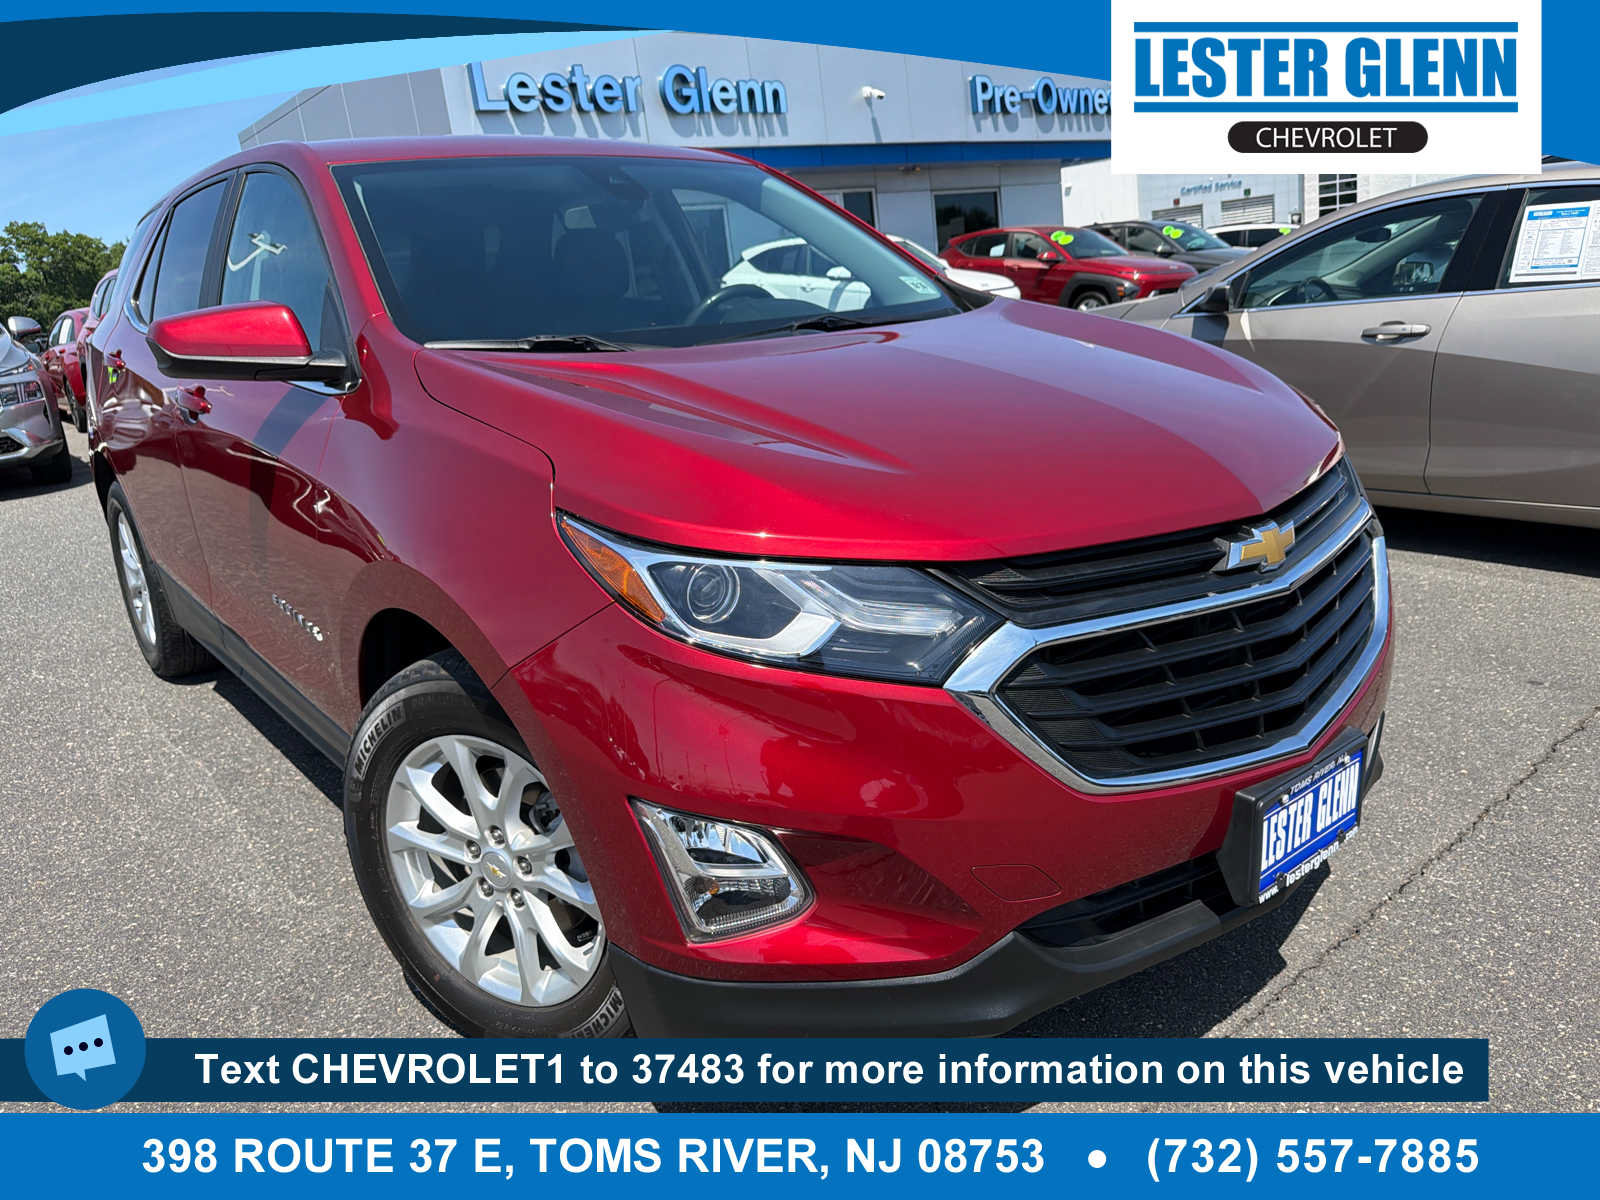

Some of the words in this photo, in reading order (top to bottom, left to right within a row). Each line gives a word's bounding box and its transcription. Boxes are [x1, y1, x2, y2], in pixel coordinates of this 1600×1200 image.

[466, 61, 642, 113] Lester
[659, 63, 788, 114] Glenn
[969, 73, 1111, 115] Pre-Owne
[355, 703, 403, 775] MICHELIN
[1261, 792, 1314, 872] LESTER
[1316, 761, 1360, 833] GLENN
